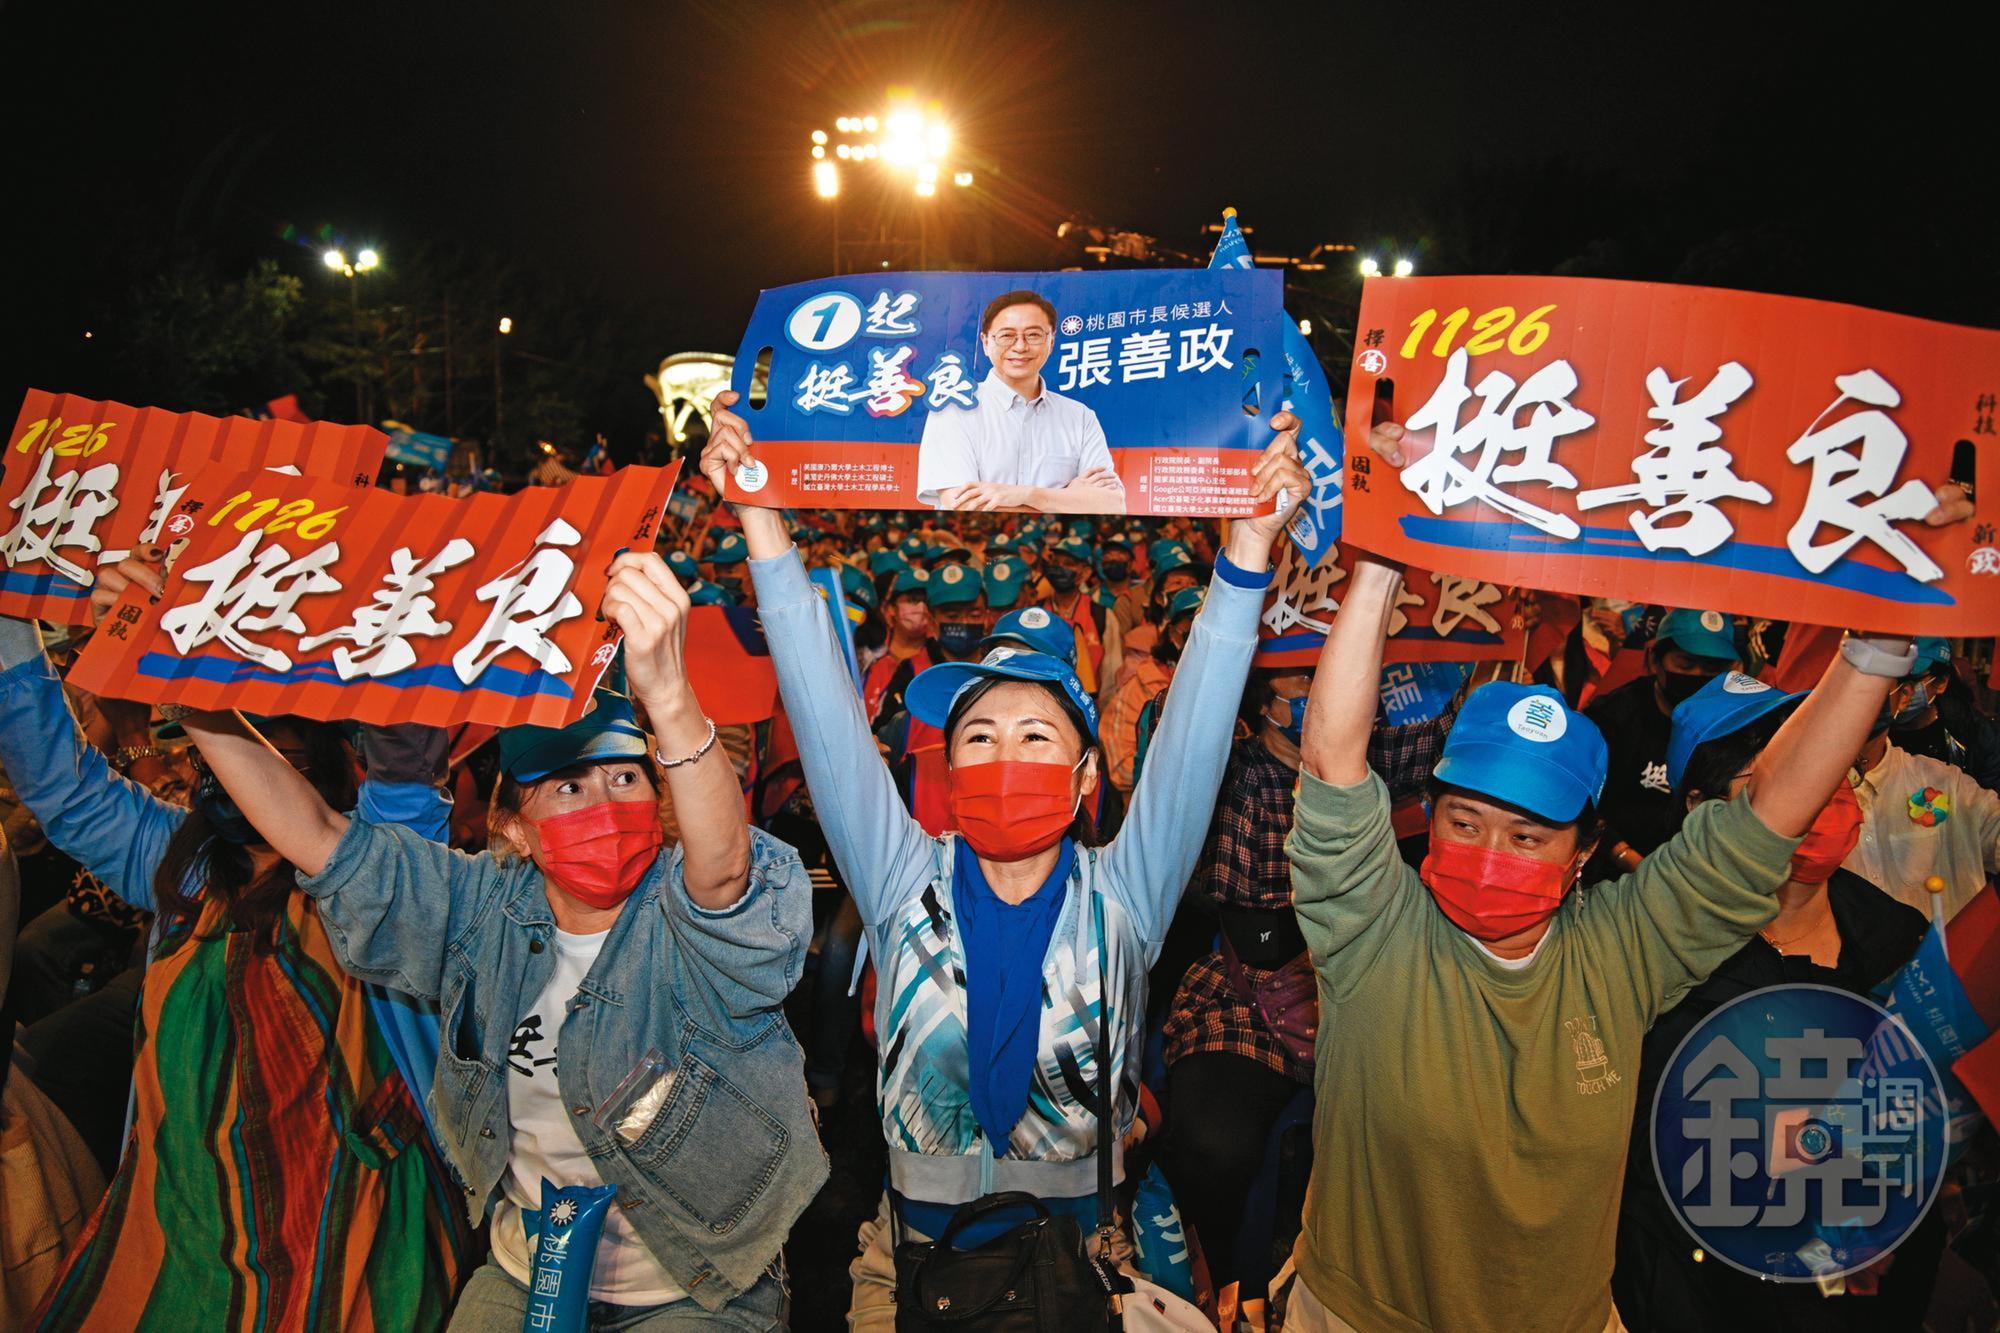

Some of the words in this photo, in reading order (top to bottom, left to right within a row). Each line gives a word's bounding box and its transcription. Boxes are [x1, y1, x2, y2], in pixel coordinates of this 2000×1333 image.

[1086, 300, 1233, 332] 桃園市長候選人
[1400, 305, 1557, 359] 1126
[797, 346, 974, 412] 挺善良
[1058, 323, 1234, 391] 張善政
[16, 417, 117, 457] 1126
[1400, 347, 1944, 583] 挺善良
[1352, 456, 1371, 493] 固執
[208, 490, 348, 540] 1126
[161, 517, 583, 685] 挺善良
[1261, 542, 1502, 637] 挺良
[1576, 1080, 1606, 1095] TOUCH
[1606, 1070, 1621, 1087] ME
[530, 1230, 569, 1332] 桃園市
